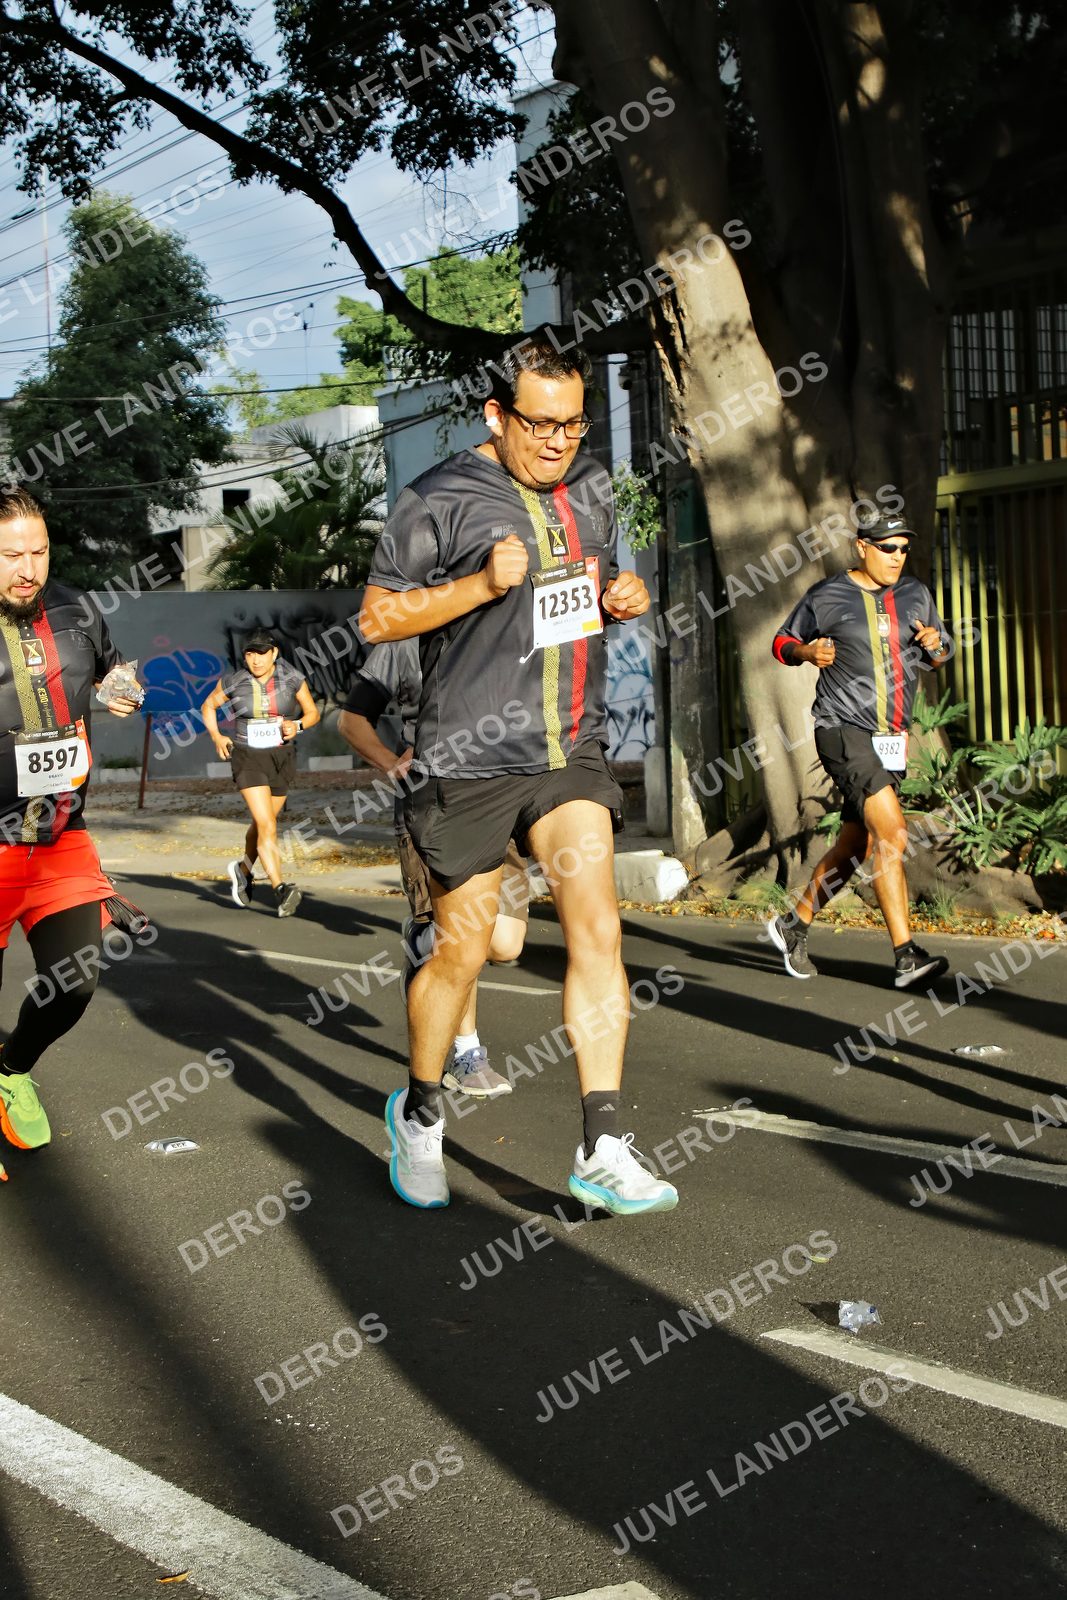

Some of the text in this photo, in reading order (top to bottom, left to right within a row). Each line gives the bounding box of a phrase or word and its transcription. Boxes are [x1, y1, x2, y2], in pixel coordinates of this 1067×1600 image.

[538, 585, 593, 620] 12353
[28, 746, 78, 774] 8597
[878, 742, 900, 755] 9382
